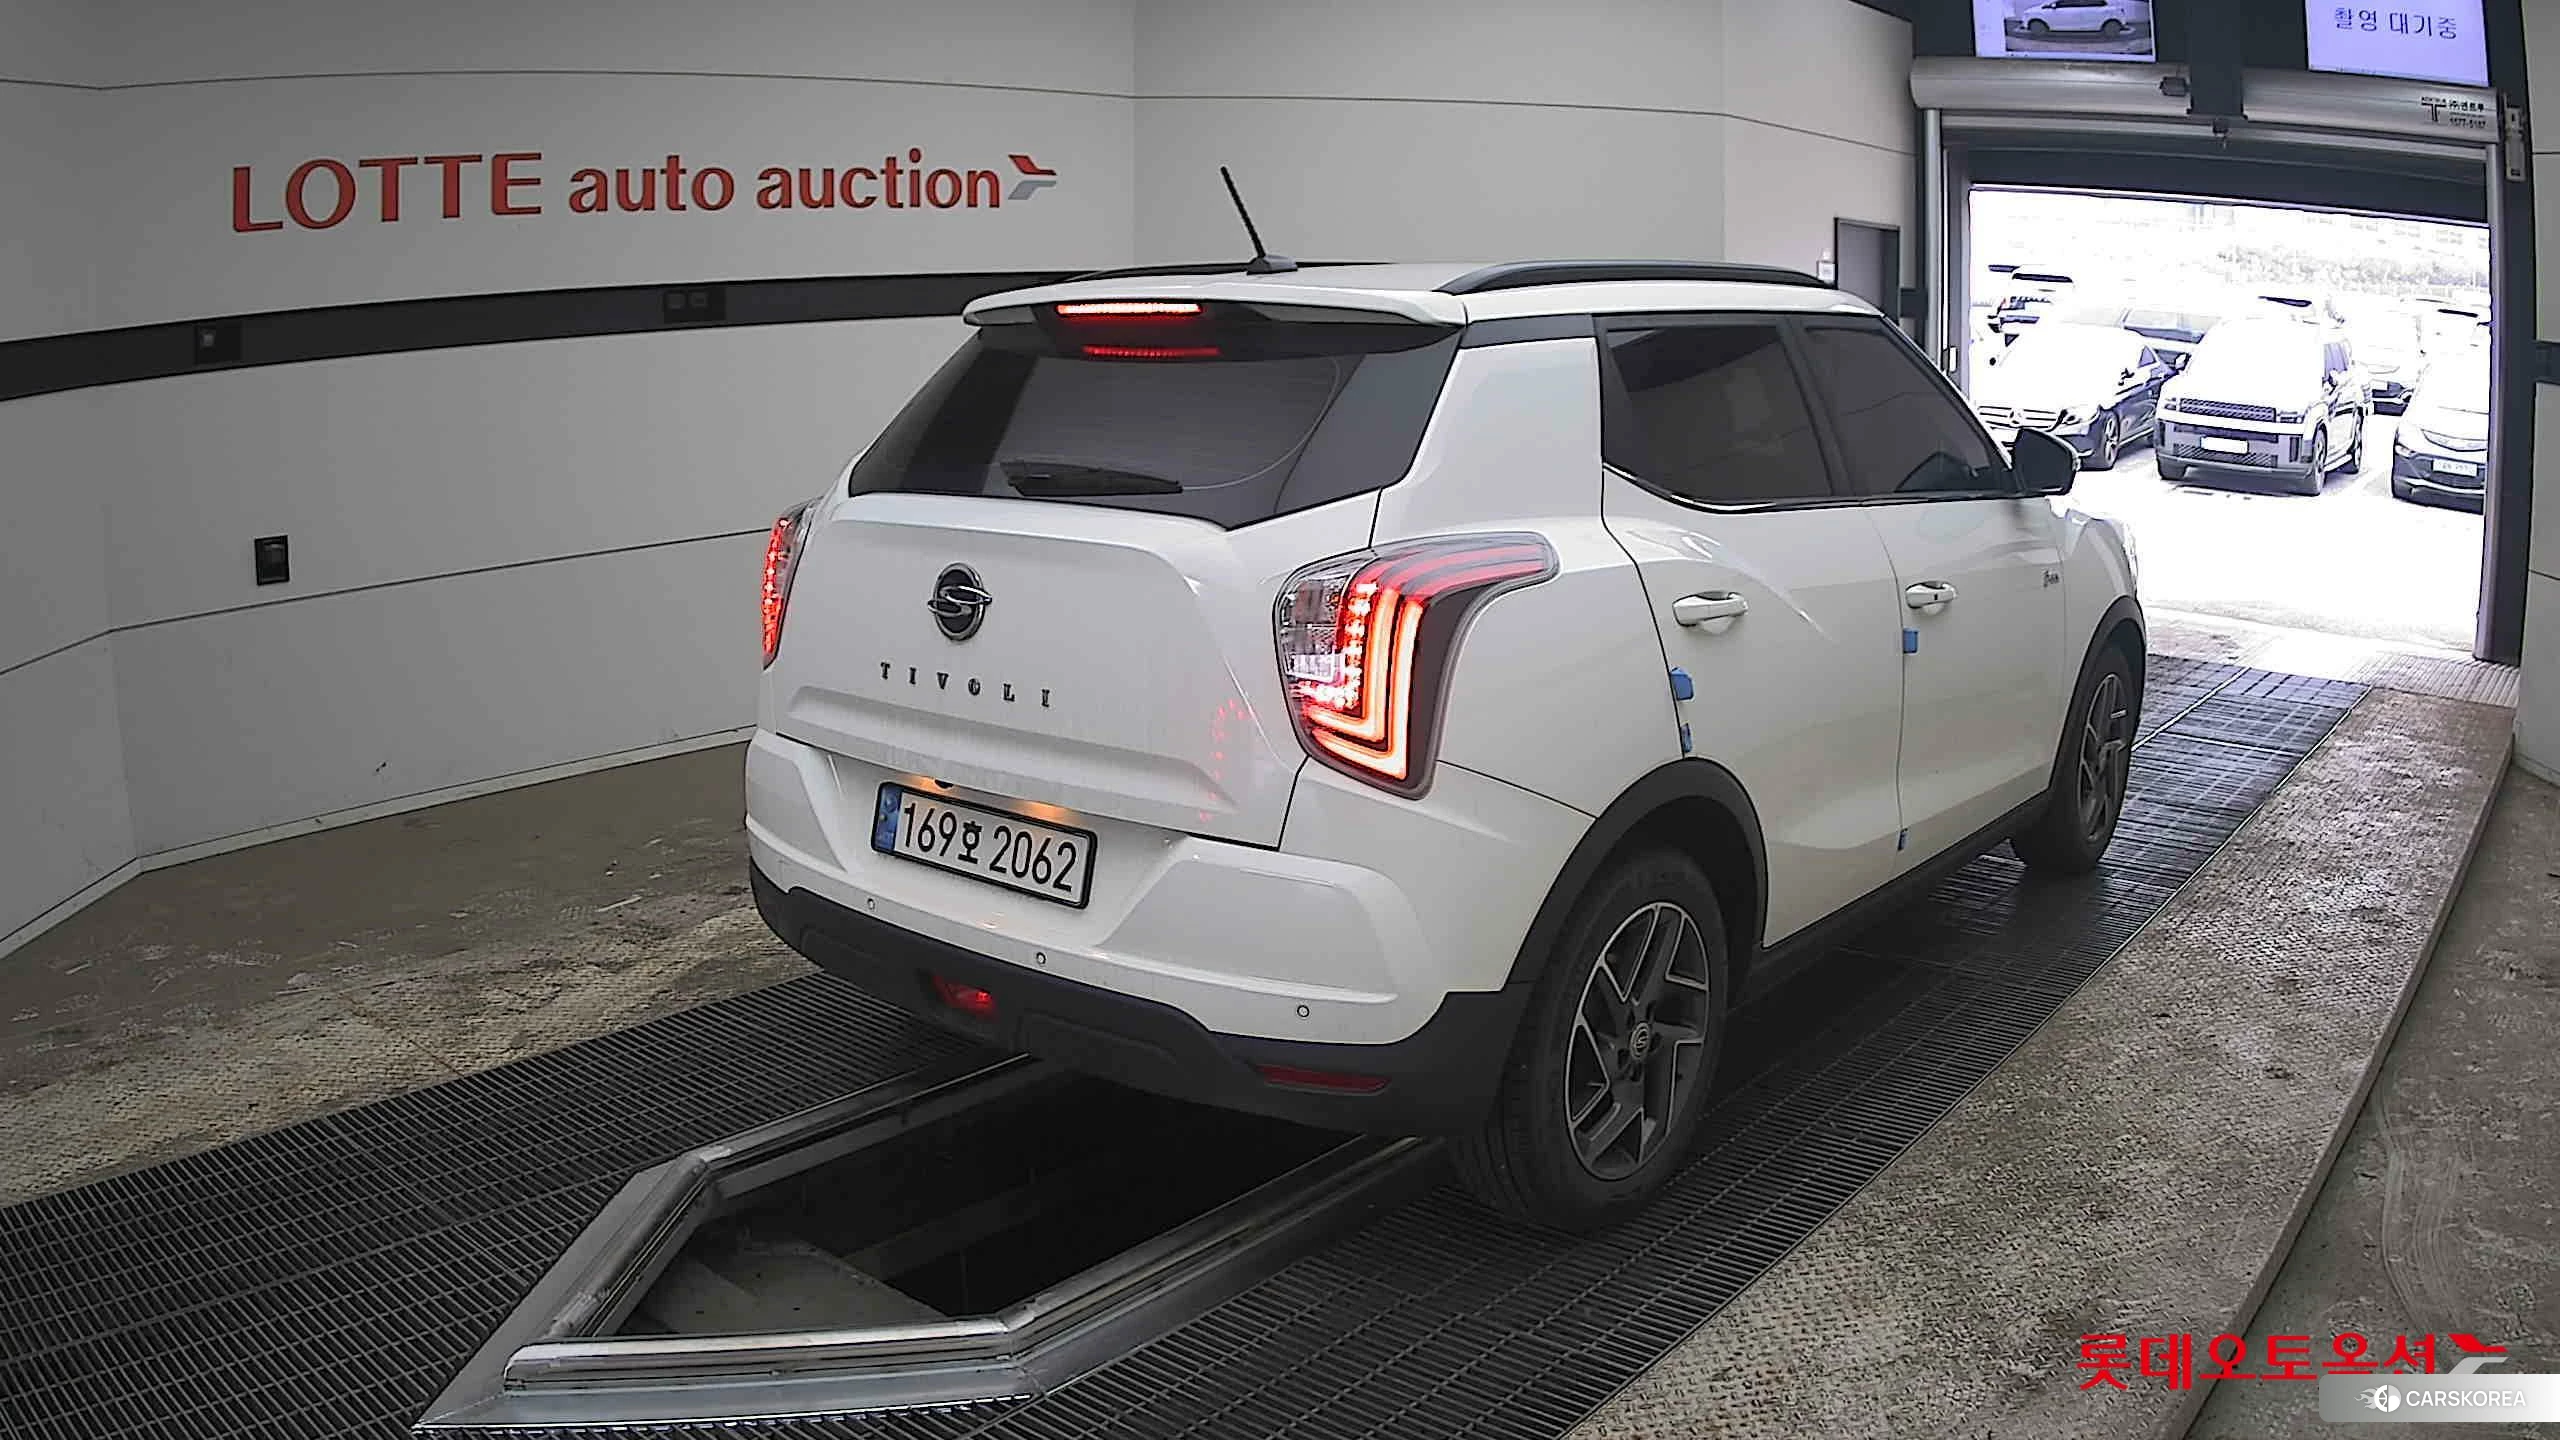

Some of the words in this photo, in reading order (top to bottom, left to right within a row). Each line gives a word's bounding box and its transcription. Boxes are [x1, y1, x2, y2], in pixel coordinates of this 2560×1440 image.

[234, 152, 542, 232] LOTTE
[568, 155, 735, 213] auto
[757, 148, 1001, 209] auction
[880, 662, 1050, 708] TIVOLI
[904, 802, 984, 864] 169호
[989, 824, 1077, 892] 2062
